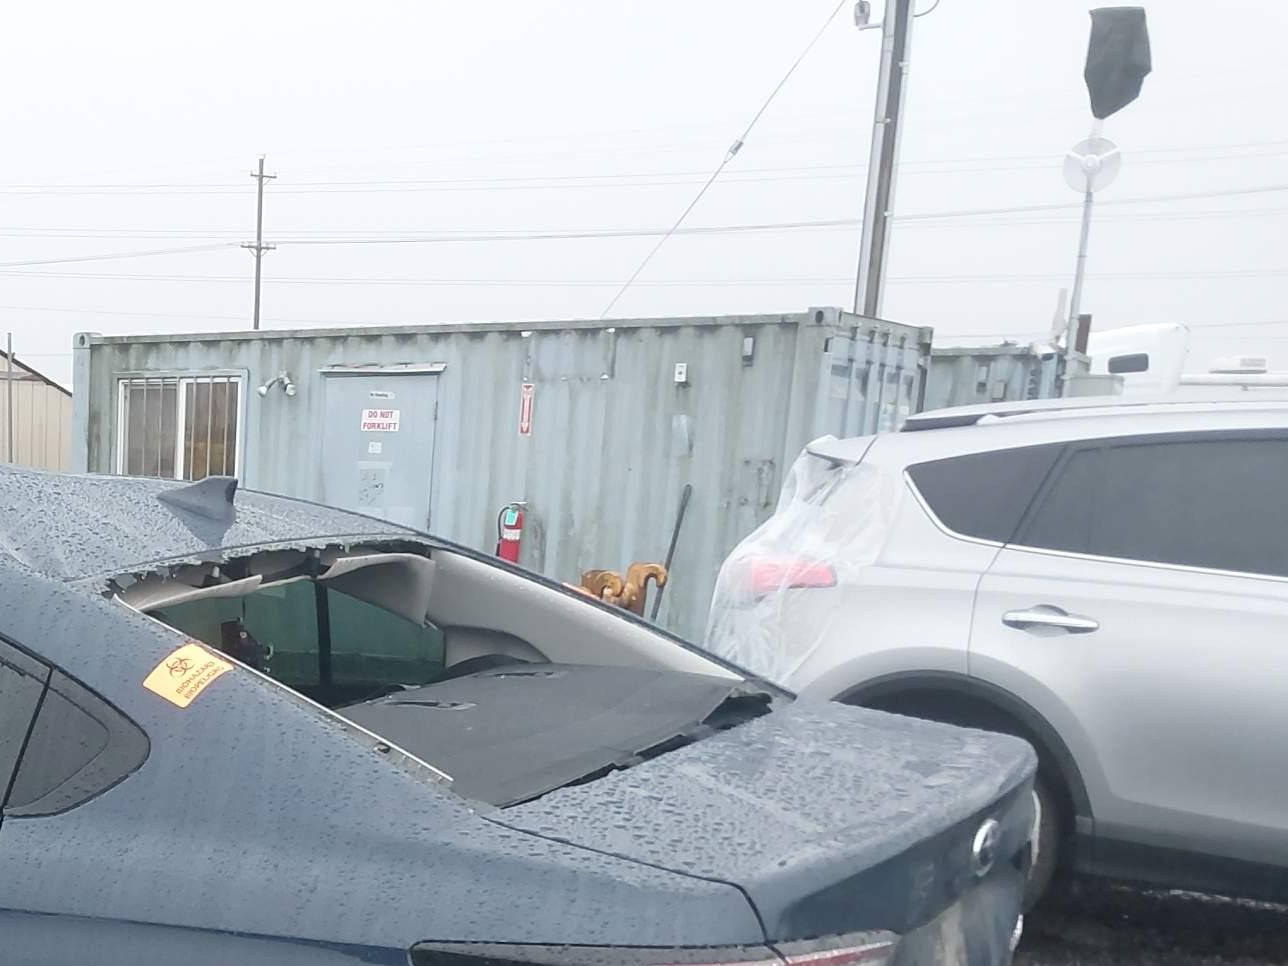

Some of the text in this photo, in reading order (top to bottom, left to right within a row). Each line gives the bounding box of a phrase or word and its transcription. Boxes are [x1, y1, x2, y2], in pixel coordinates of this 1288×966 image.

[367, 410, 394, 419] DO NOT
[362, 422, 397, 430] FORKLIFT
[175, 661, 216, 695] BIOHAZARD
